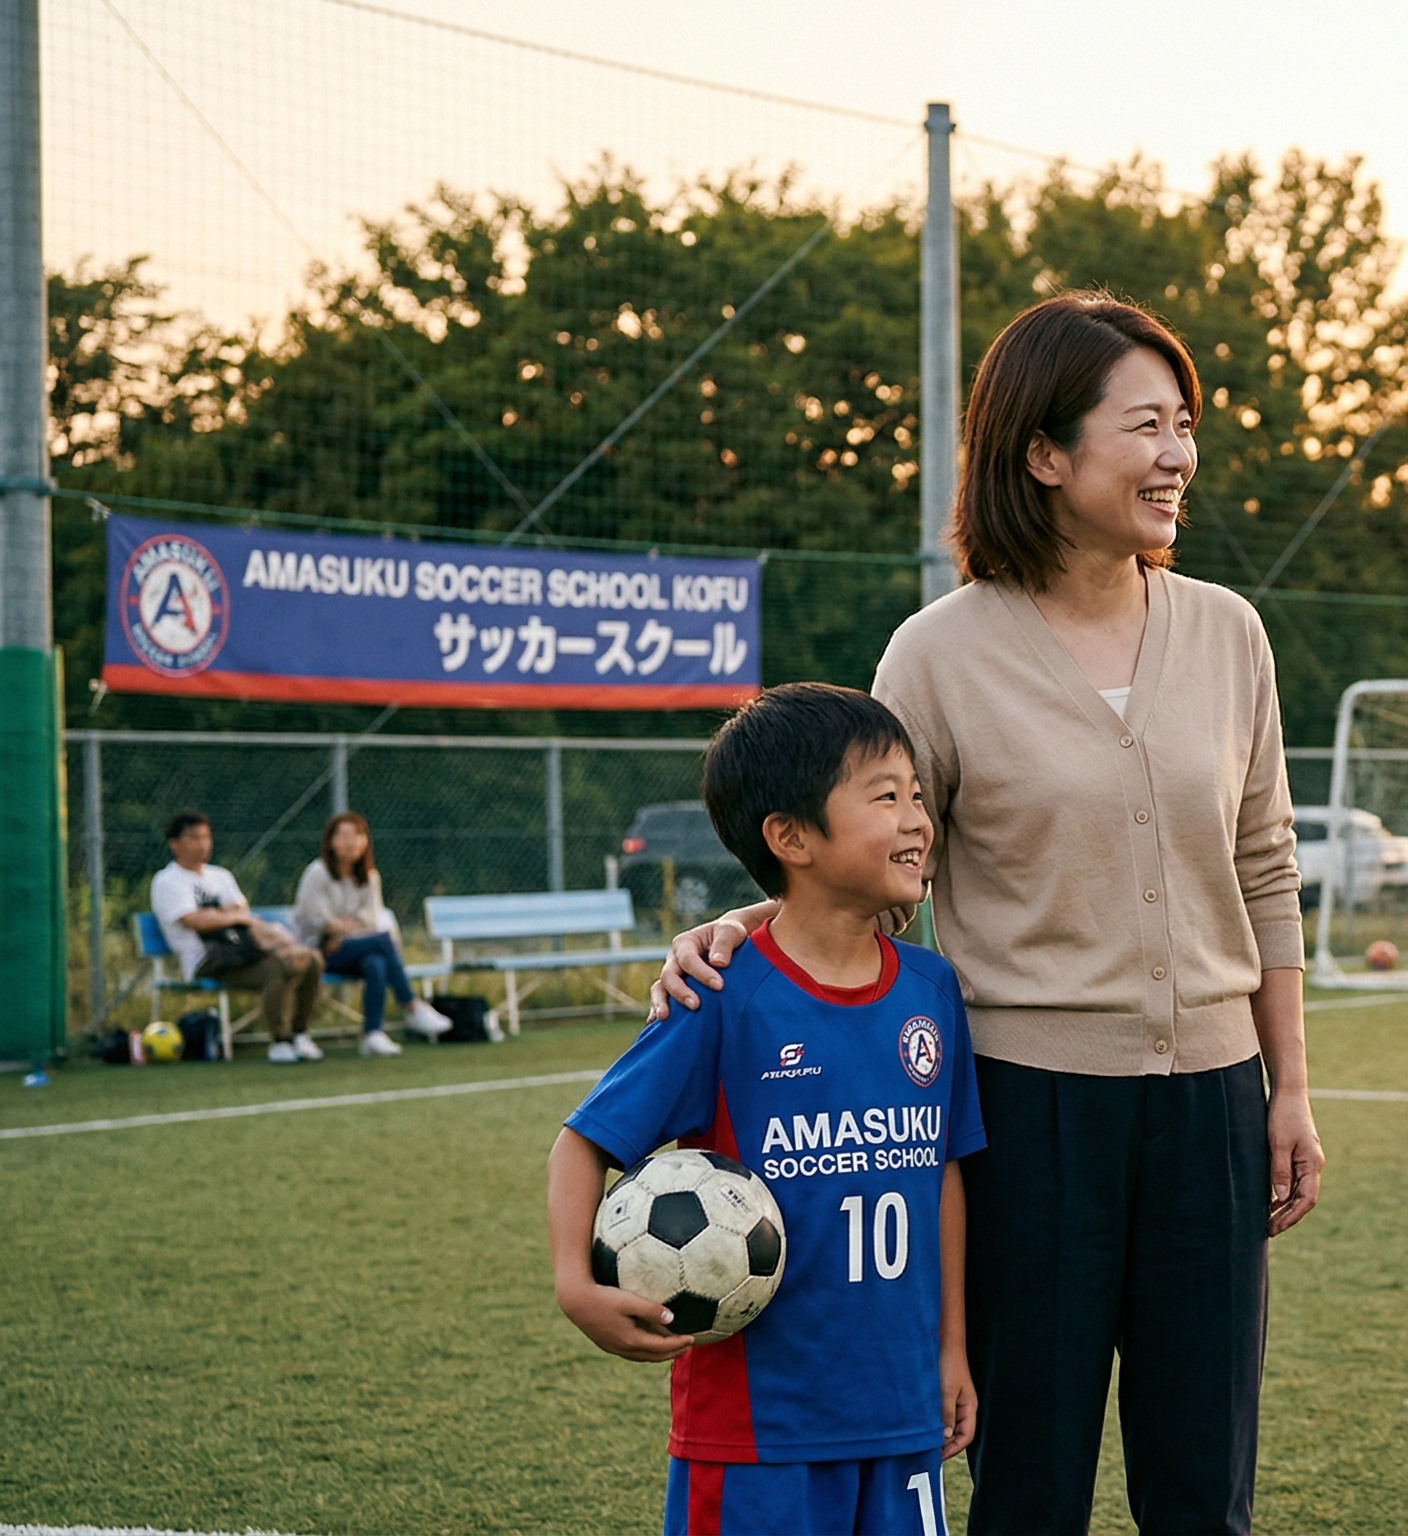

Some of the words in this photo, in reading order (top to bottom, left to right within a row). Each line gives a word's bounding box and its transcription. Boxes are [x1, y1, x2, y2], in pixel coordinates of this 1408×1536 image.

[243, 549, 409, 598] AMASUKU
[415, 561, 541, 604] SOCCER
[548, 568, 669, 609] SCHOOL
[673, 575, 748, 612] KOFU
[433, 612, 747, 675] サッカースクール
[761, 1105, 941, 1153] AMASUKU
[763, 1152, 868, 1179] SOCCER
[874, 1147, 938, 1171] SCHOOL
[839, 1191, 909, 1283] 10
[907, 1472, 937, 1536] 1
